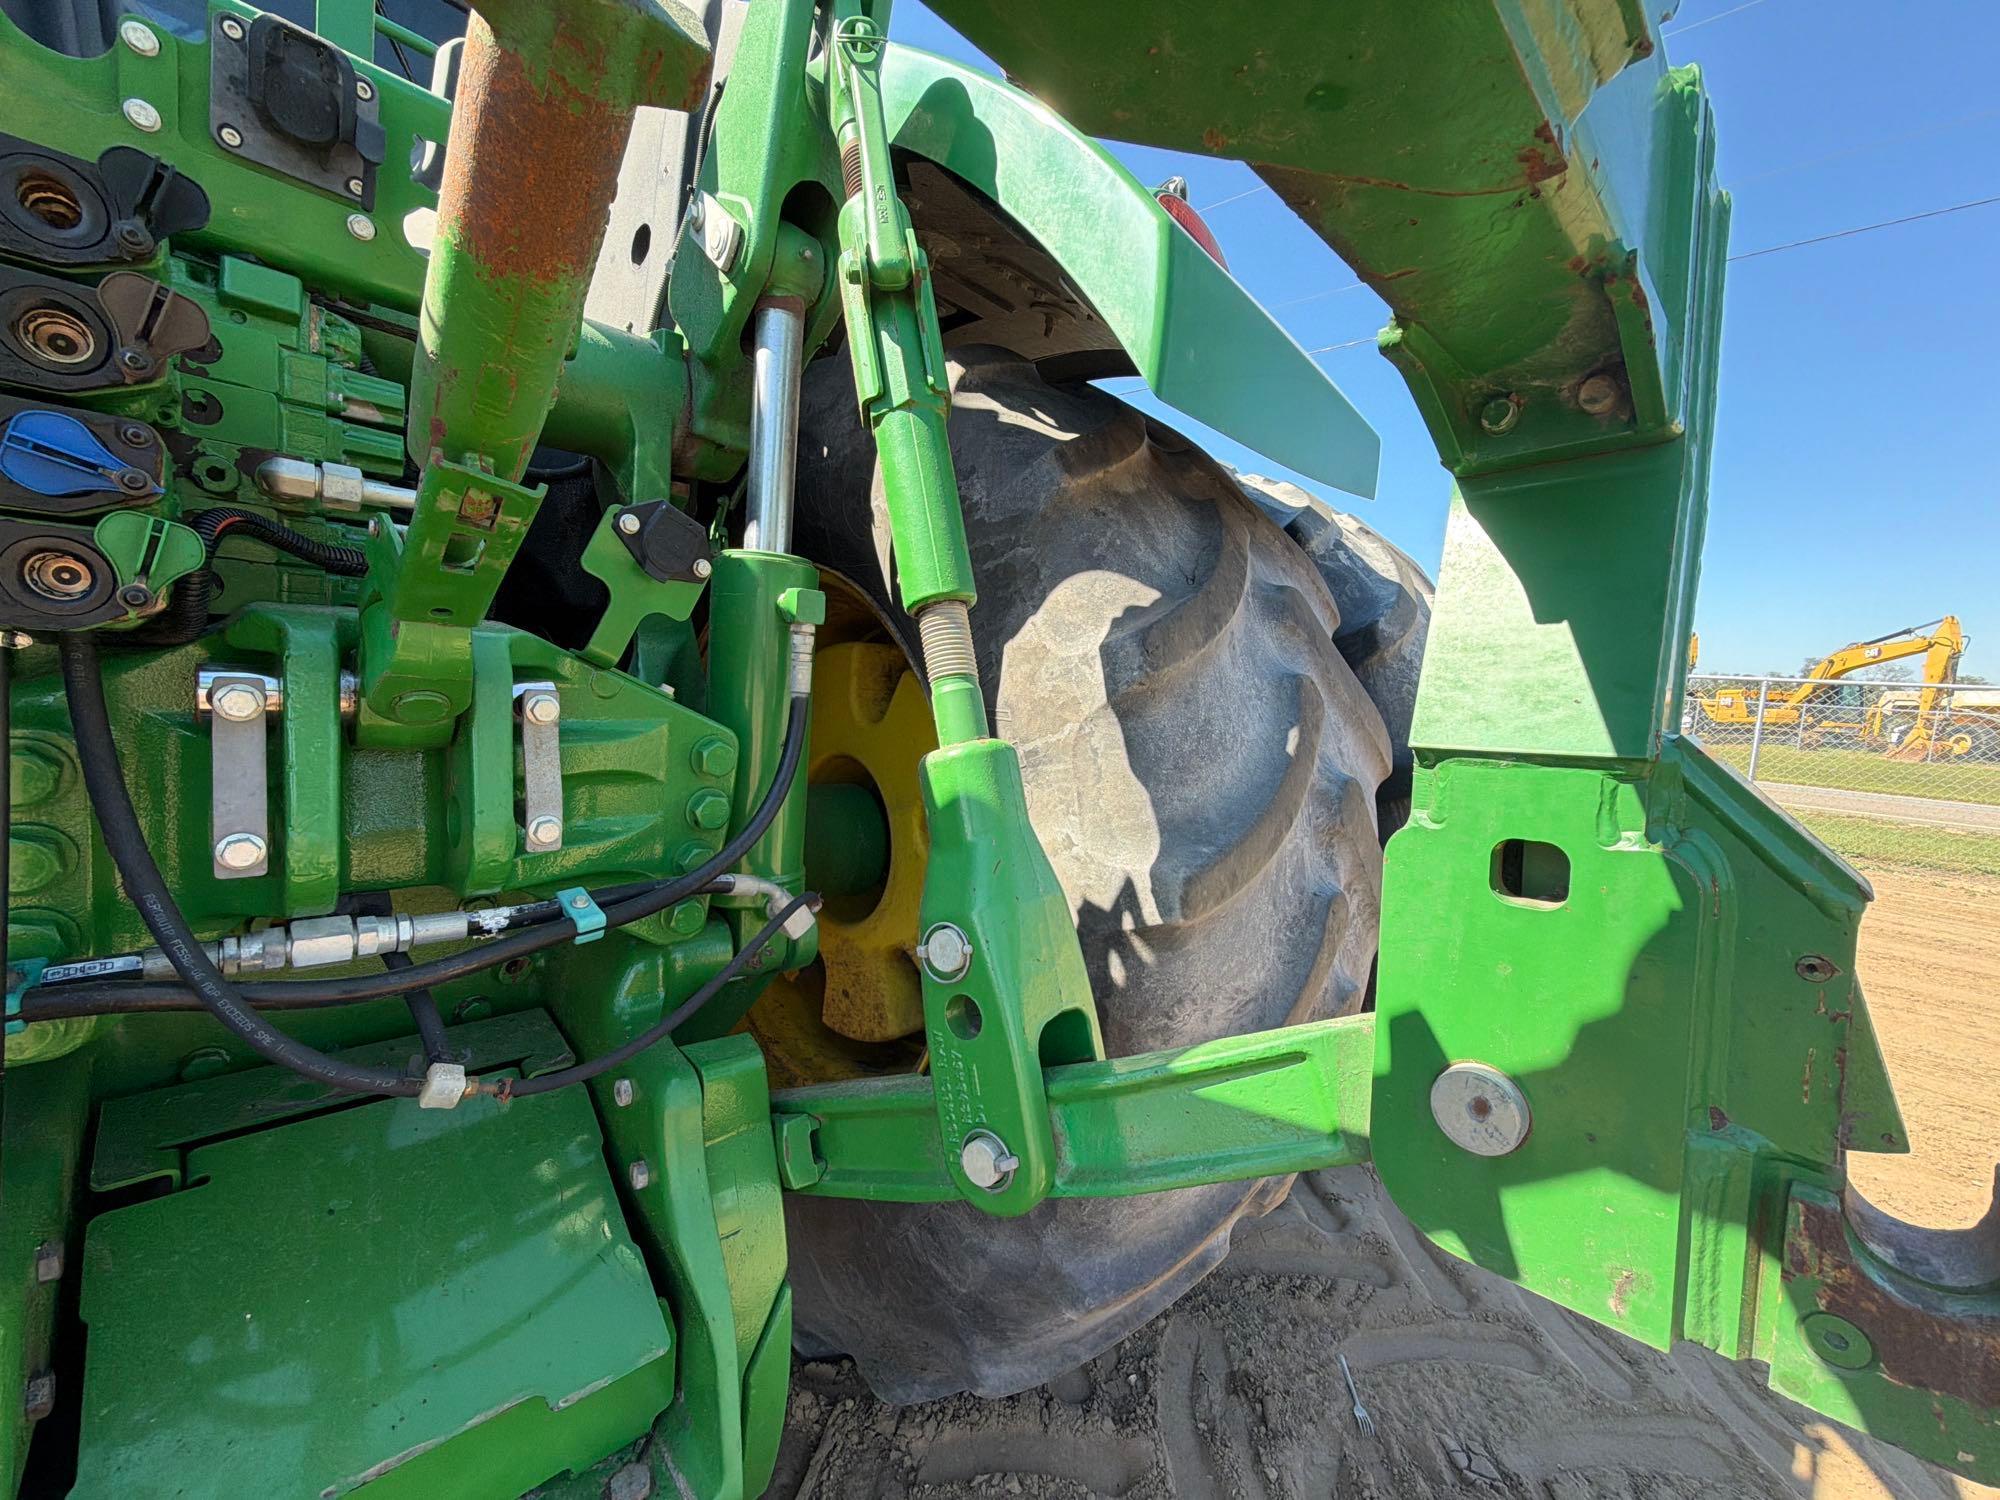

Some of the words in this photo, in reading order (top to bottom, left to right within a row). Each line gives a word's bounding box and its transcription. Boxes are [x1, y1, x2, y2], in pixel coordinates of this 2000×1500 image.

[1863, 647, 1880, 659] CAT
[217, 999, 255, 1031] EXCEEDS
[254, 1031, 275, 1046] SAE
